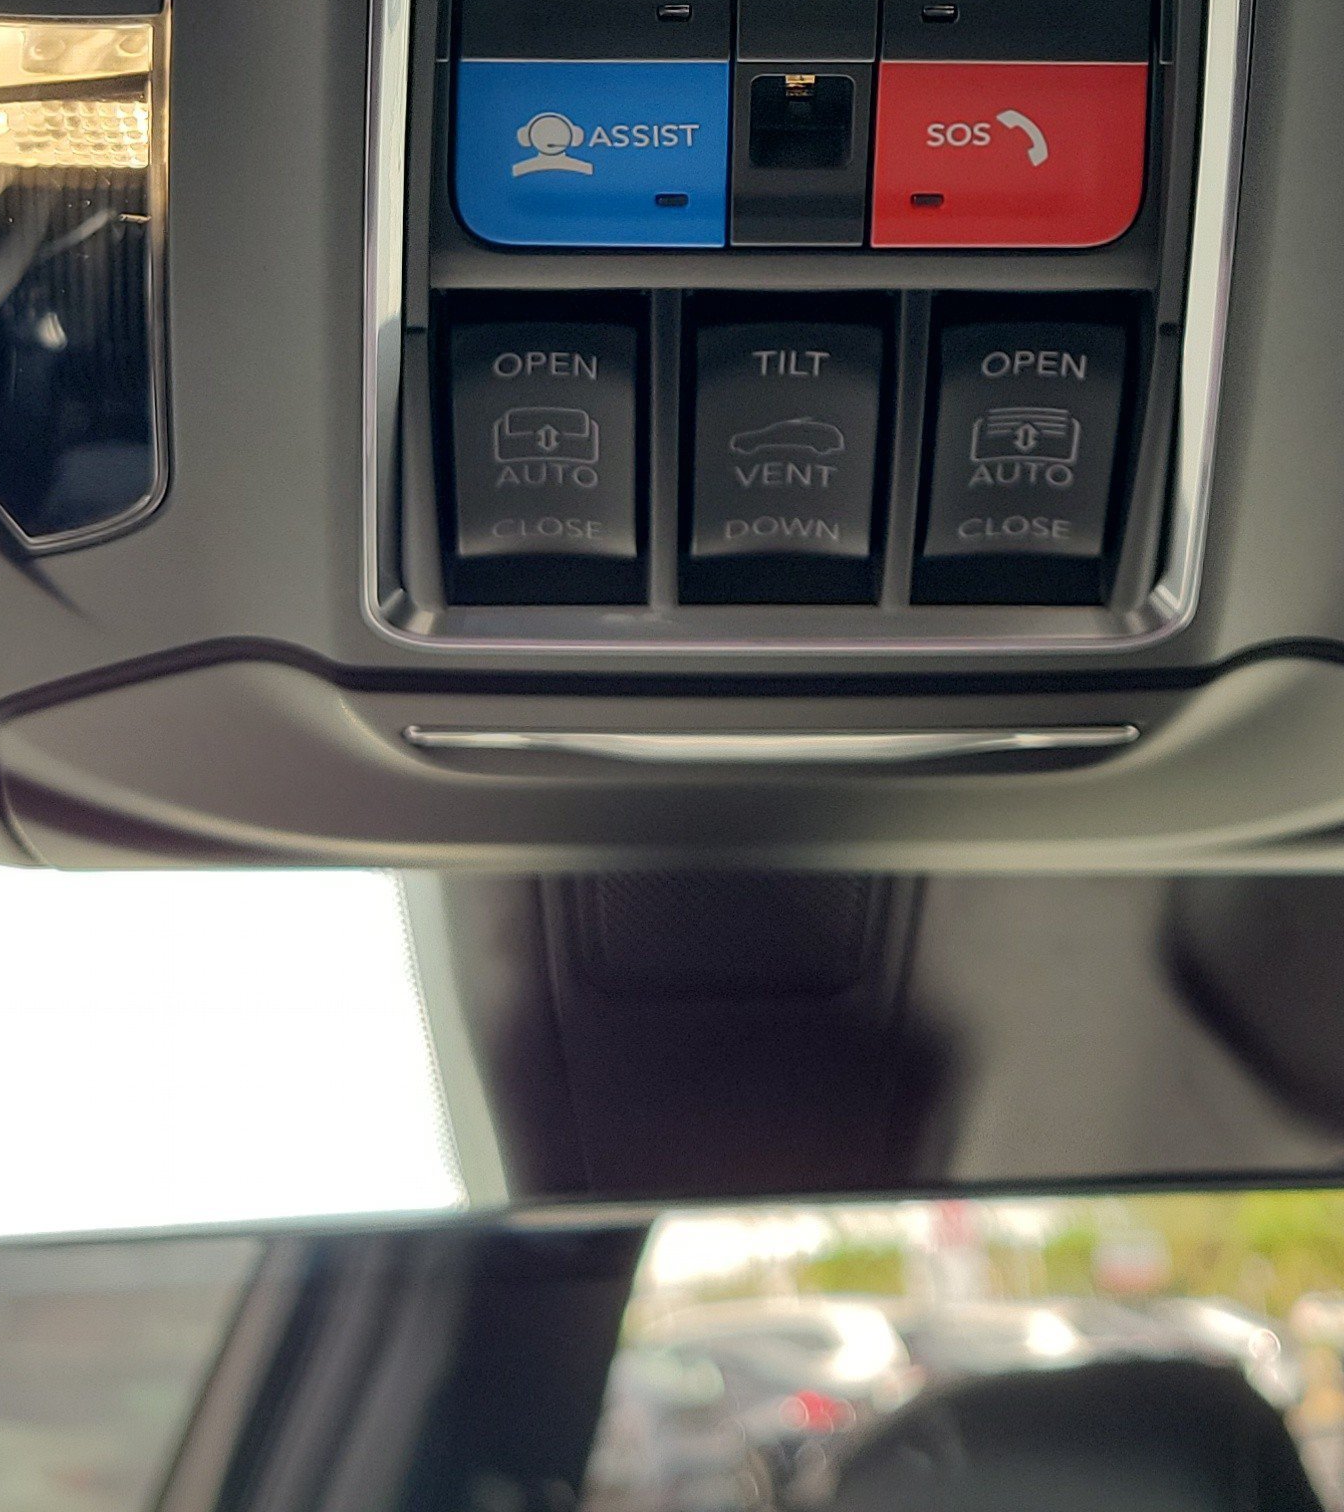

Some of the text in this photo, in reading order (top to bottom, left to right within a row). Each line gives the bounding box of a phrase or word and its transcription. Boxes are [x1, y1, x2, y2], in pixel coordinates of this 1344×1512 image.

[589, 124, 700, 148] ASSIST
[926, 123, 991, 147] SOS
[492, 351, 598, 379] OPEN
[752, 350, 830, 377] TILT
[981, 351, 1088, 379] OPEN
[496, 464, 598, 488] AUTO
[735, 464, 836, 487] VENT
[969, 462, 1074, 487] AUTO
[491, 517, 604, 540] CLOSE
[725, 516, 840, 541] DOWN
[958, 516, 1071, 540] CLOSE
